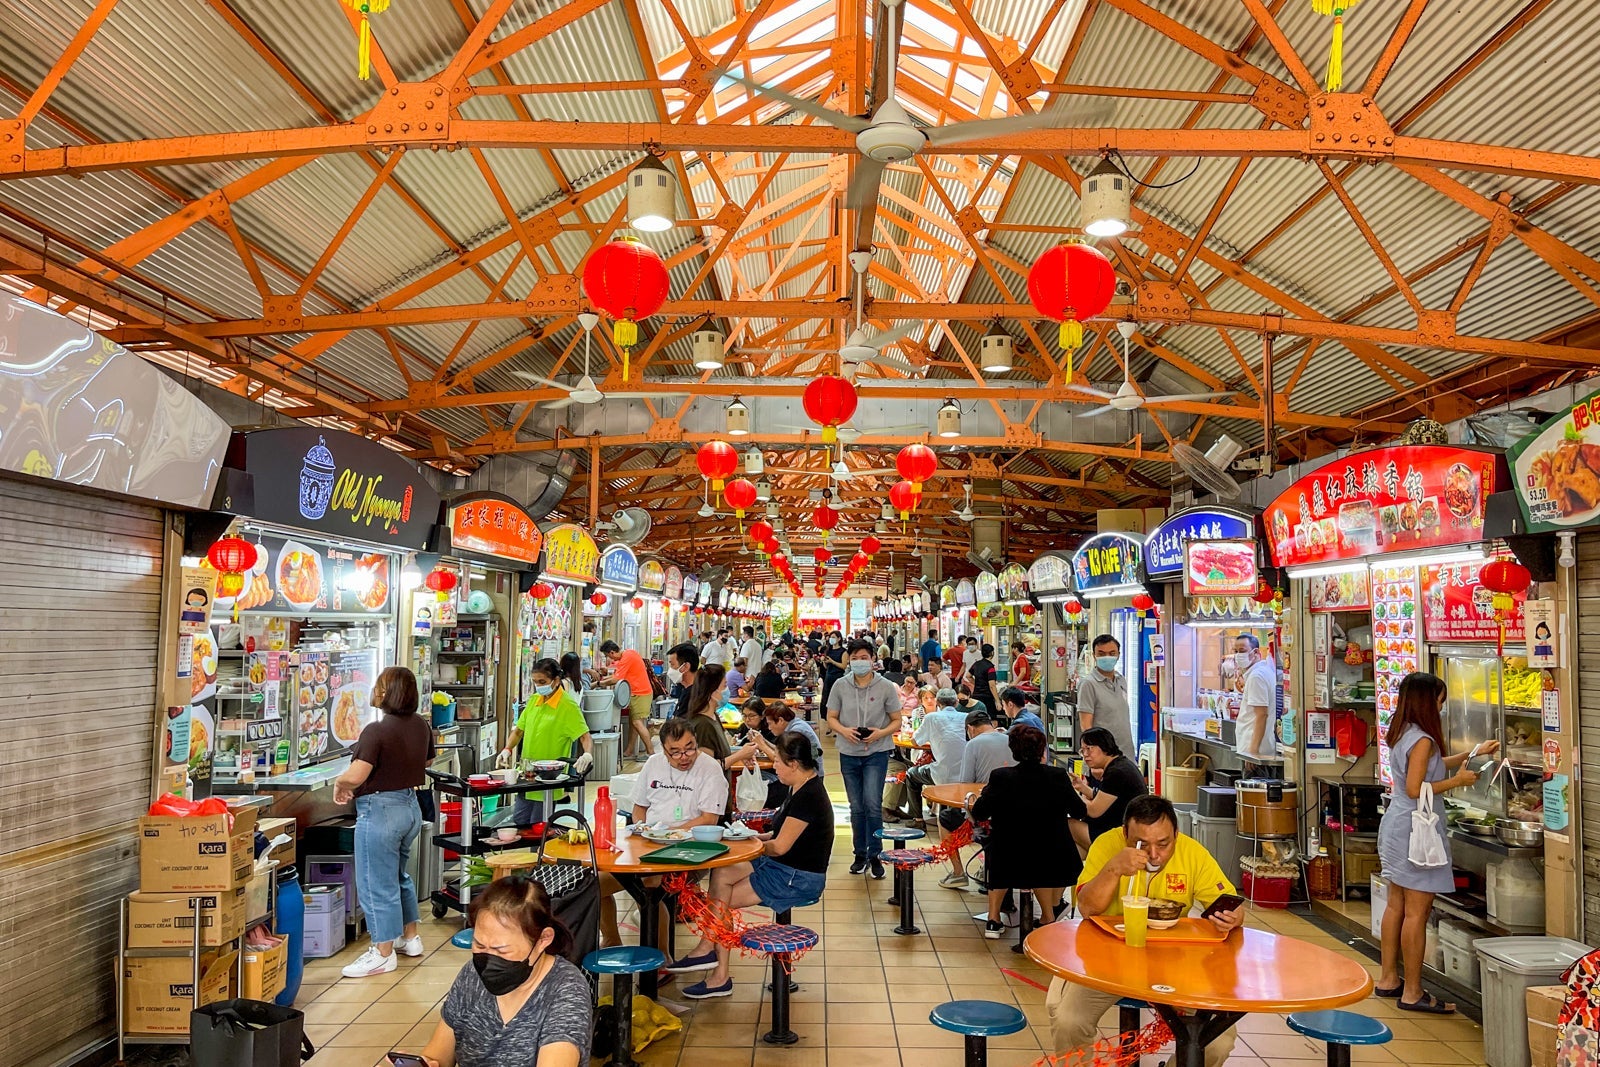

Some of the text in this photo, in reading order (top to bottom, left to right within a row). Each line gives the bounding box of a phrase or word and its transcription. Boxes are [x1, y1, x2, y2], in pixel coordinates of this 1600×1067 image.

[224, 496, 232, 509] 3
[331, 468, 364, 511] Old
[352, 475, 402, 531] Nyonya
[1088, 548, 1101, 577] K3
[1101, 547, 1121, 575] CAFE
[650, 780, 694, 792] Champion
[201, 843, 224, 853] kara
[191, 897, 214, 907] kra
[172, 985, 194, 996] kara
